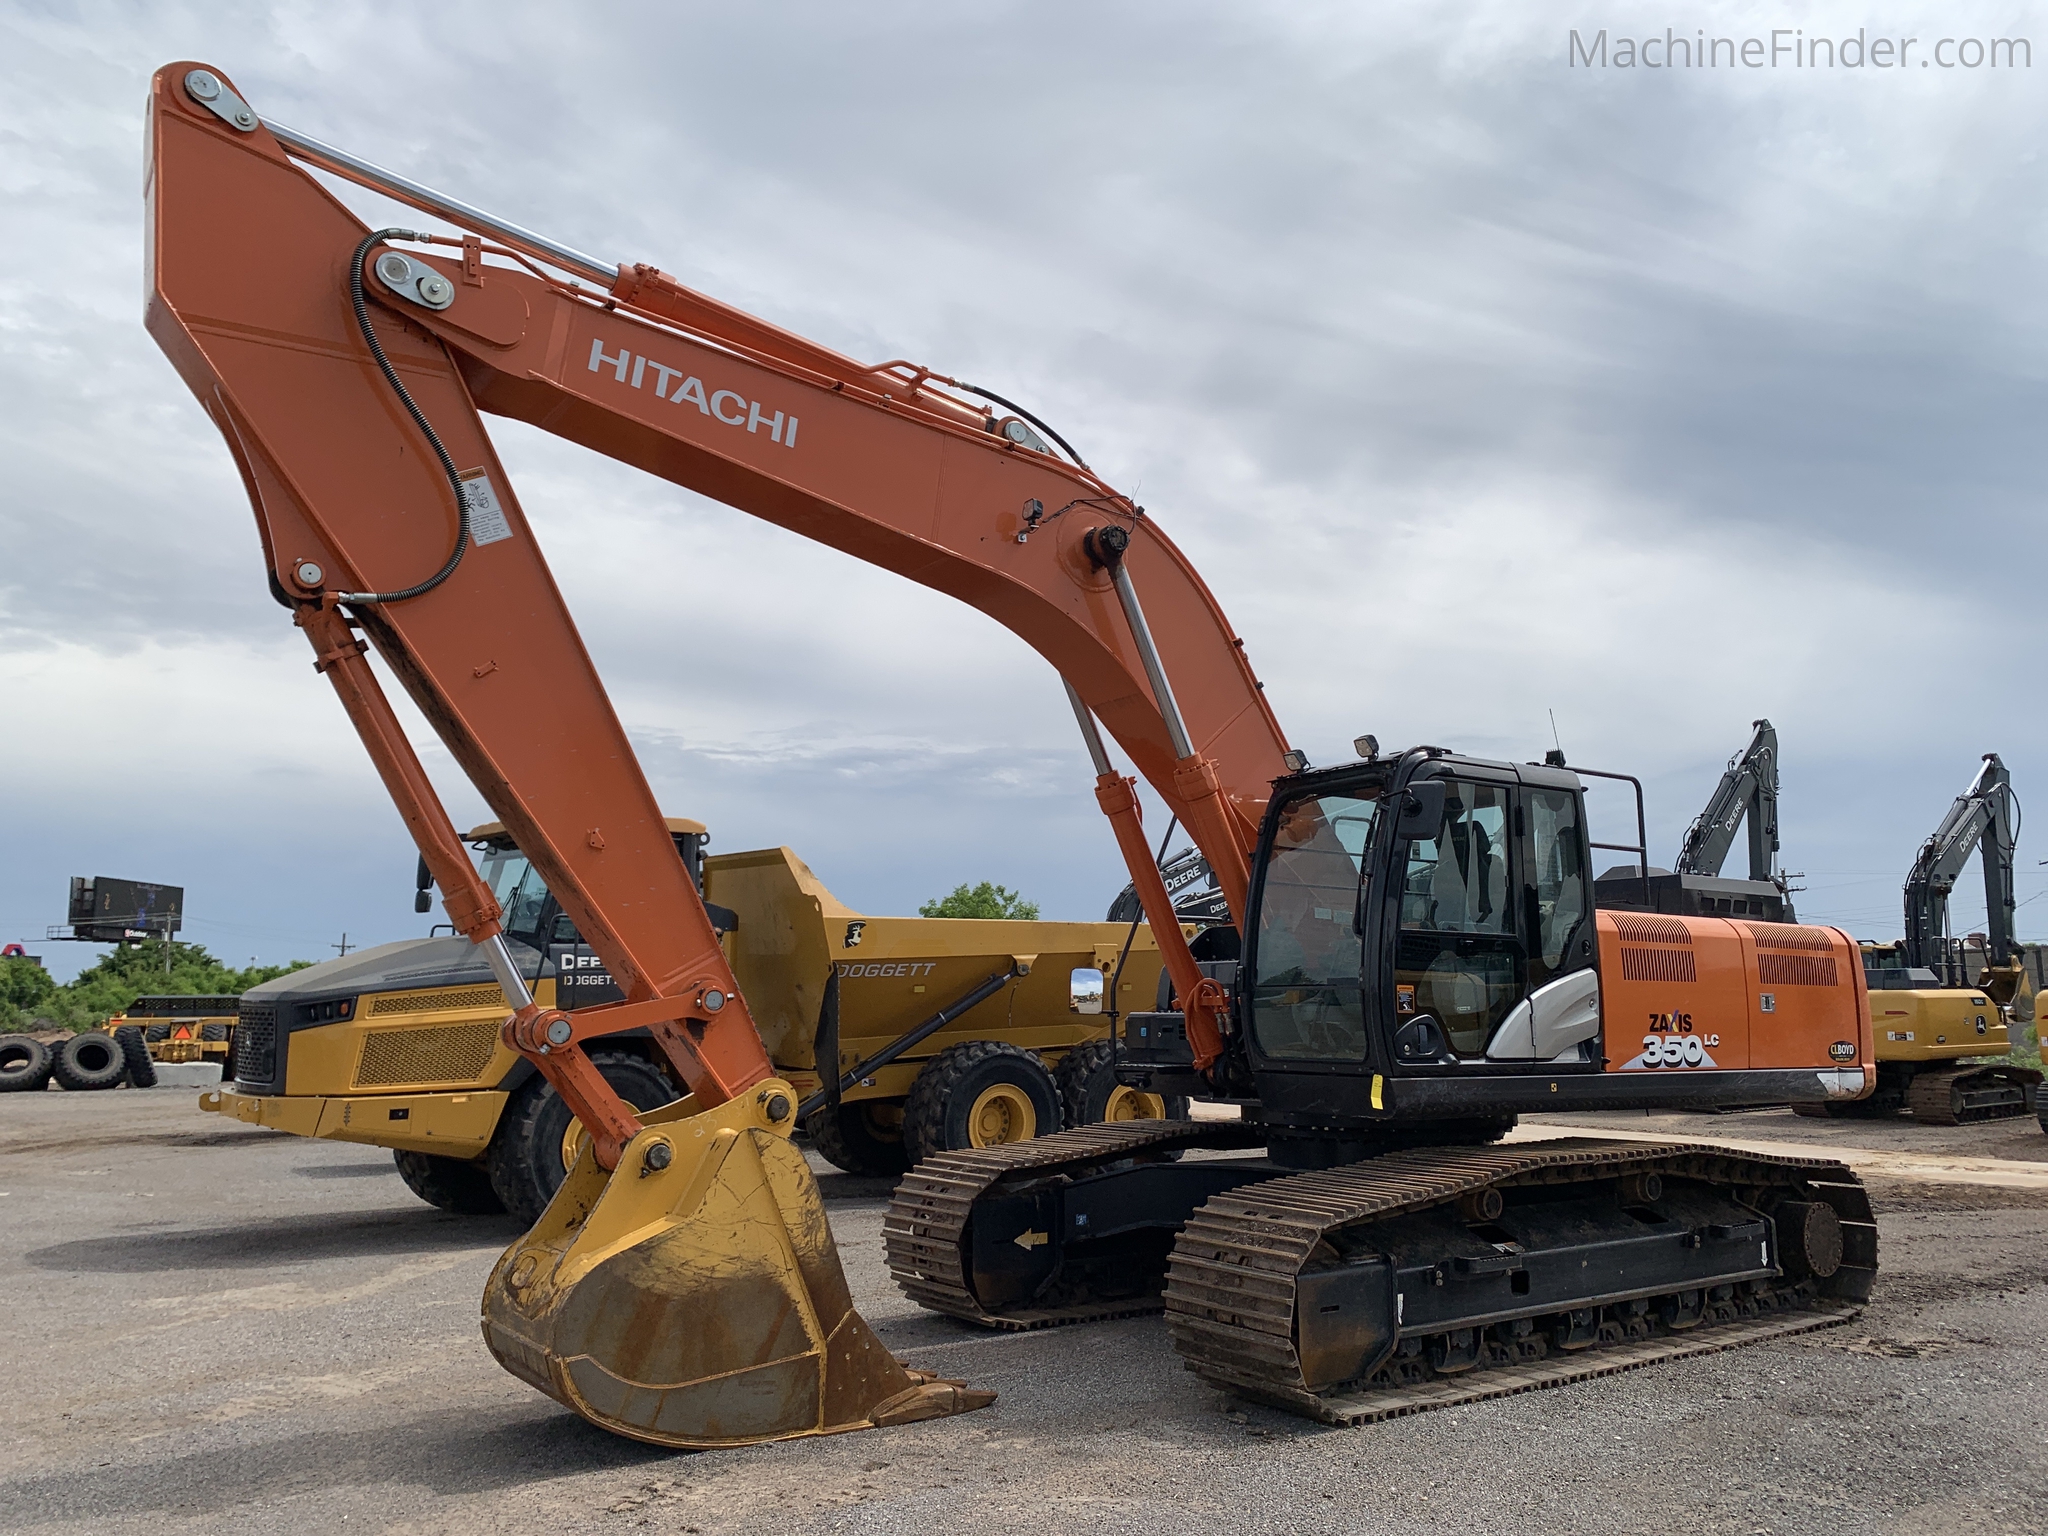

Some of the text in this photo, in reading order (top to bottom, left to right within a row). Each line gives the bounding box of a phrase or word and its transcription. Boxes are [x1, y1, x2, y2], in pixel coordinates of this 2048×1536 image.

[587, 338, 799, 449] HITACHI
[1725, 797, 1744, 832] DEERE
[1959, 821, 1979, 853] DEERE
[1164, 865, 1202, 892] DEERE
[1649, 1009, 1693, 1033] ZAXIS
[1642, 1034, 1703, 1069] 350
